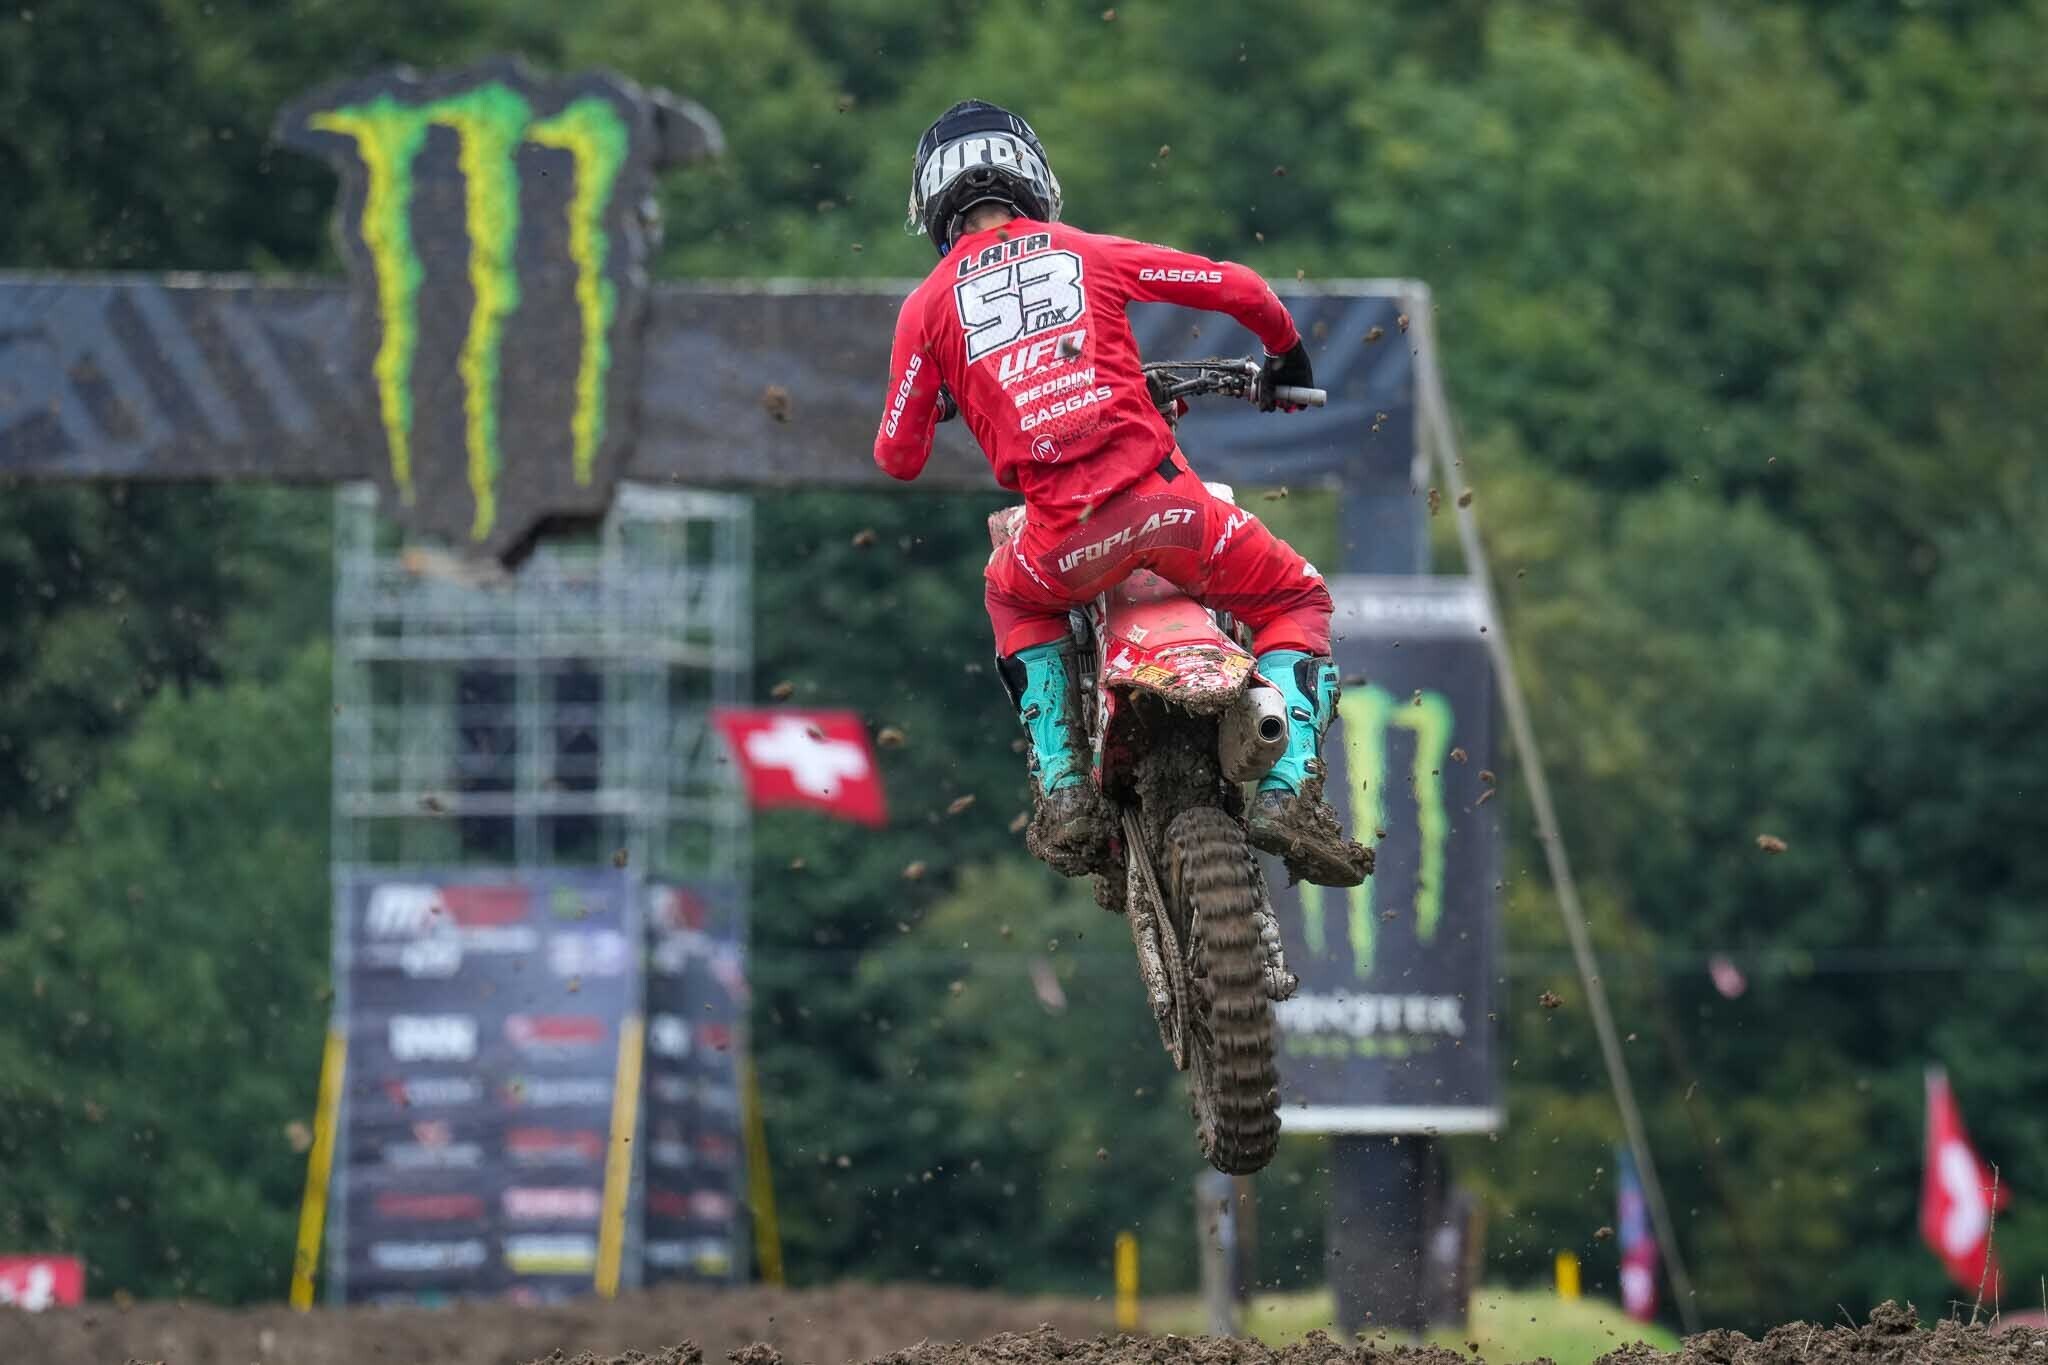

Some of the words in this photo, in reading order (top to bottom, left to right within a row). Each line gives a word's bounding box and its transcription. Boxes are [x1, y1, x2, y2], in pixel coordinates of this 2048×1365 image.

[957, 232, 1051, 278] LATA
[1139, 268, 1223, 283] GASGAS
[954, 249, 1086, 366] 53
[886, 353, 922, 438] GASGAS
[1020, 386, 1112, 431] GASGAS
[1057, 508, 1196, 573] UFOPLAST
